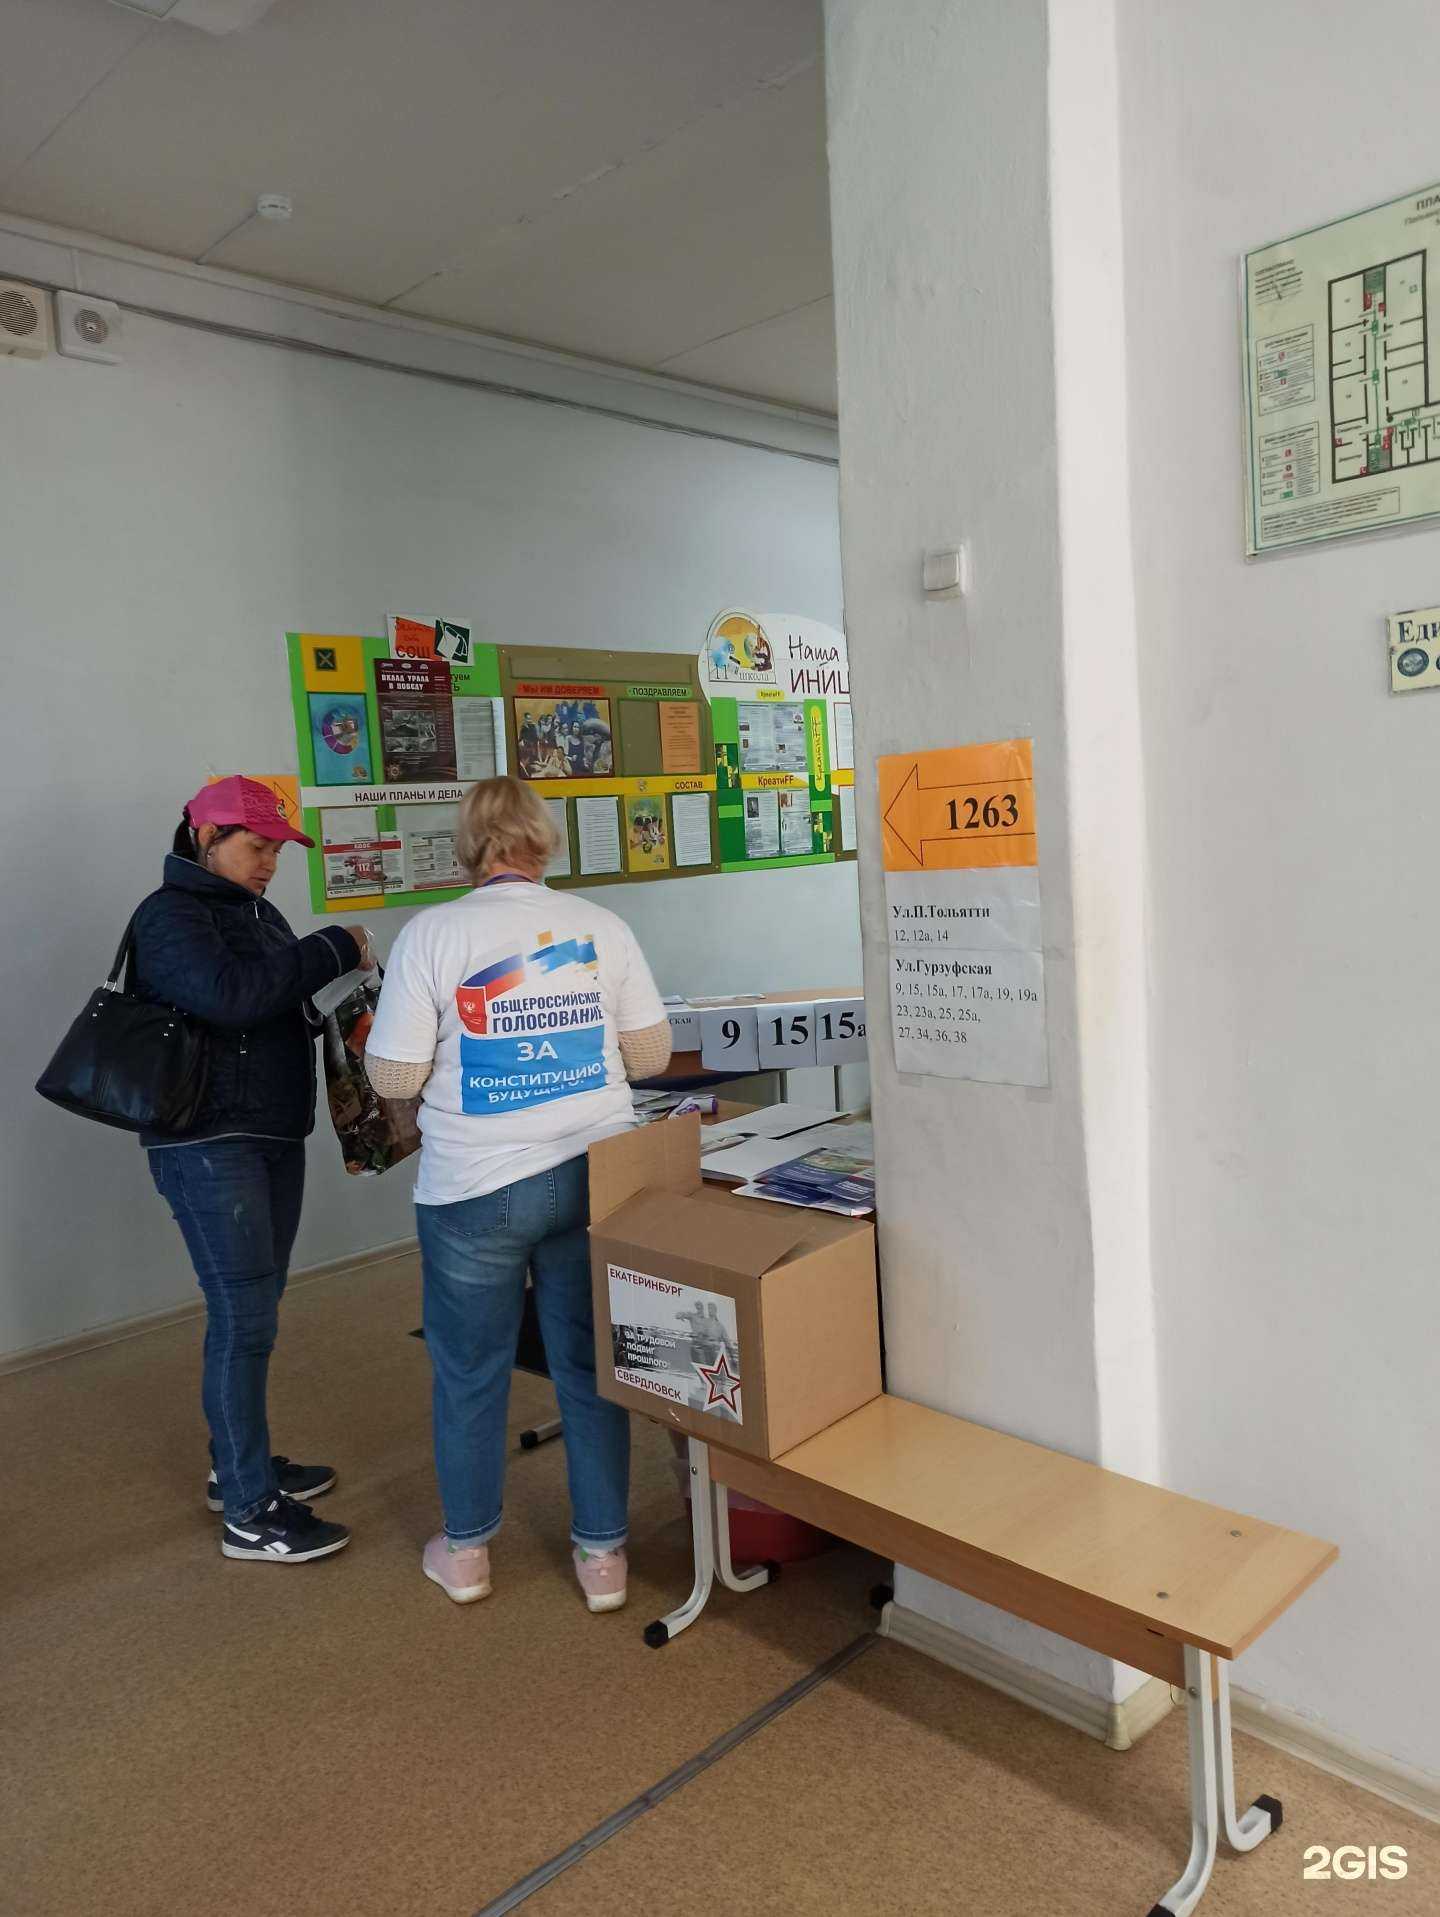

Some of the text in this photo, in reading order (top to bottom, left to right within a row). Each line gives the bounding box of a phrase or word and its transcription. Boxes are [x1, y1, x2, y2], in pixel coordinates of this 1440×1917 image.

[788, 634, 840, 667] Наша
[632, 687, 687, 697] ПОЗДРАВЛЯЕМ
[354, 788, 464, 803] НАШИ ПЛАНЫ И ДЕЛА
[674, 781, 703, 790] СОСТАВ
[945, 794, 1018, 830] 1263
[358, 863, 370, 872] 112
[892, 905, 990, 919] Ул.П.Тольятти
[937, 929, 949, 941] 14
[895, 959, 992, 977] Ул.Гурзуфская
[491, 991, 602, 1015] ОБЩЕРОССИЙСКОЕ
[492, 1006, 604, 1034] ГОЛОСОВАНИЕ
[769, 1015, 809, 1046] 15
[819, 1011, 866, 1041] 15а
[721, 1019, 742, 1050] 9
[954, 1031, 968, 1044] 38
[516, 1040, 559, 1062] ЗА
[469, 1062, 602, 1089] КОНСТИТУЦИЮ
[609, 1268, 684, 1297] ЕКАТЕРИНБУРГ
[617, 1369, 682, 1401] СВЕРДЛОВСК
